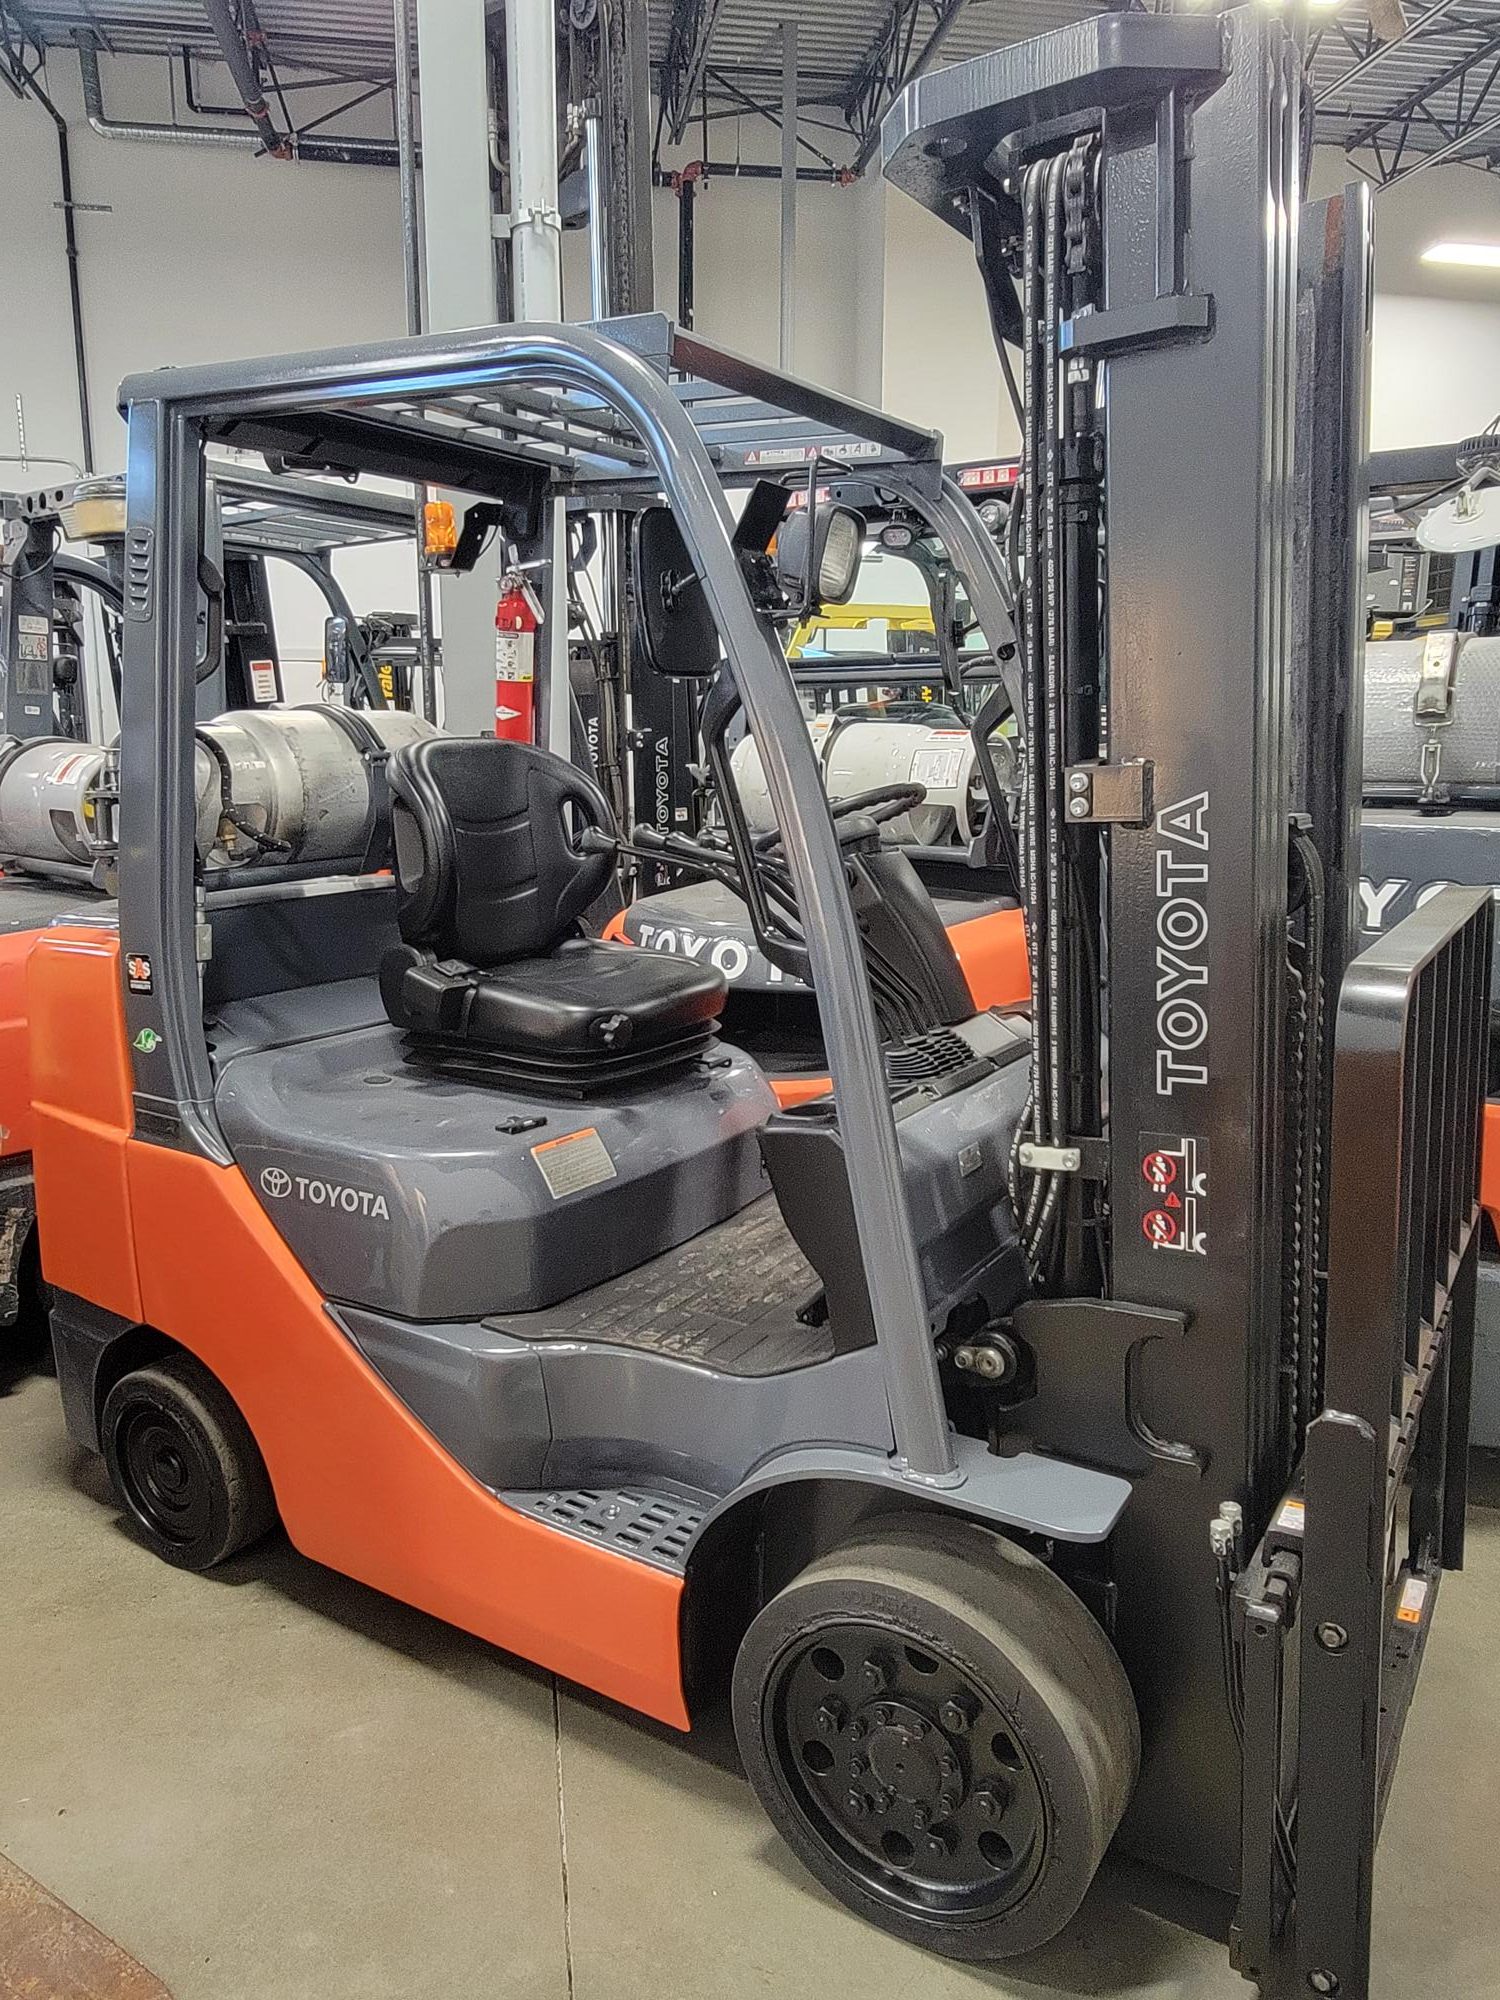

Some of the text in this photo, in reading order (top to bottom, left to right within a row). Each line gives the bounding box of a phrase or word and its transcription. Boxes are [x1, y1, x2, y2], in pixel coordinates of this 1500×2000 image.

[1026, 351, 1032, 367] WP
[1048, 593, 1055, 607] WP
[1027, 714, 1034, 728] WP
[655, 736, 670, 835] TOYOTA
[1051, 939, 1058, 952] WP
[1156, 791, 1209, 1095] TOYOTA
[638, 924, 804, 982] TOYO
[128, 957, 151, 979] SAS
[1033, 1050, 1039, 1062] WP
[295, 1176, 390, 1221] TOYOTA
